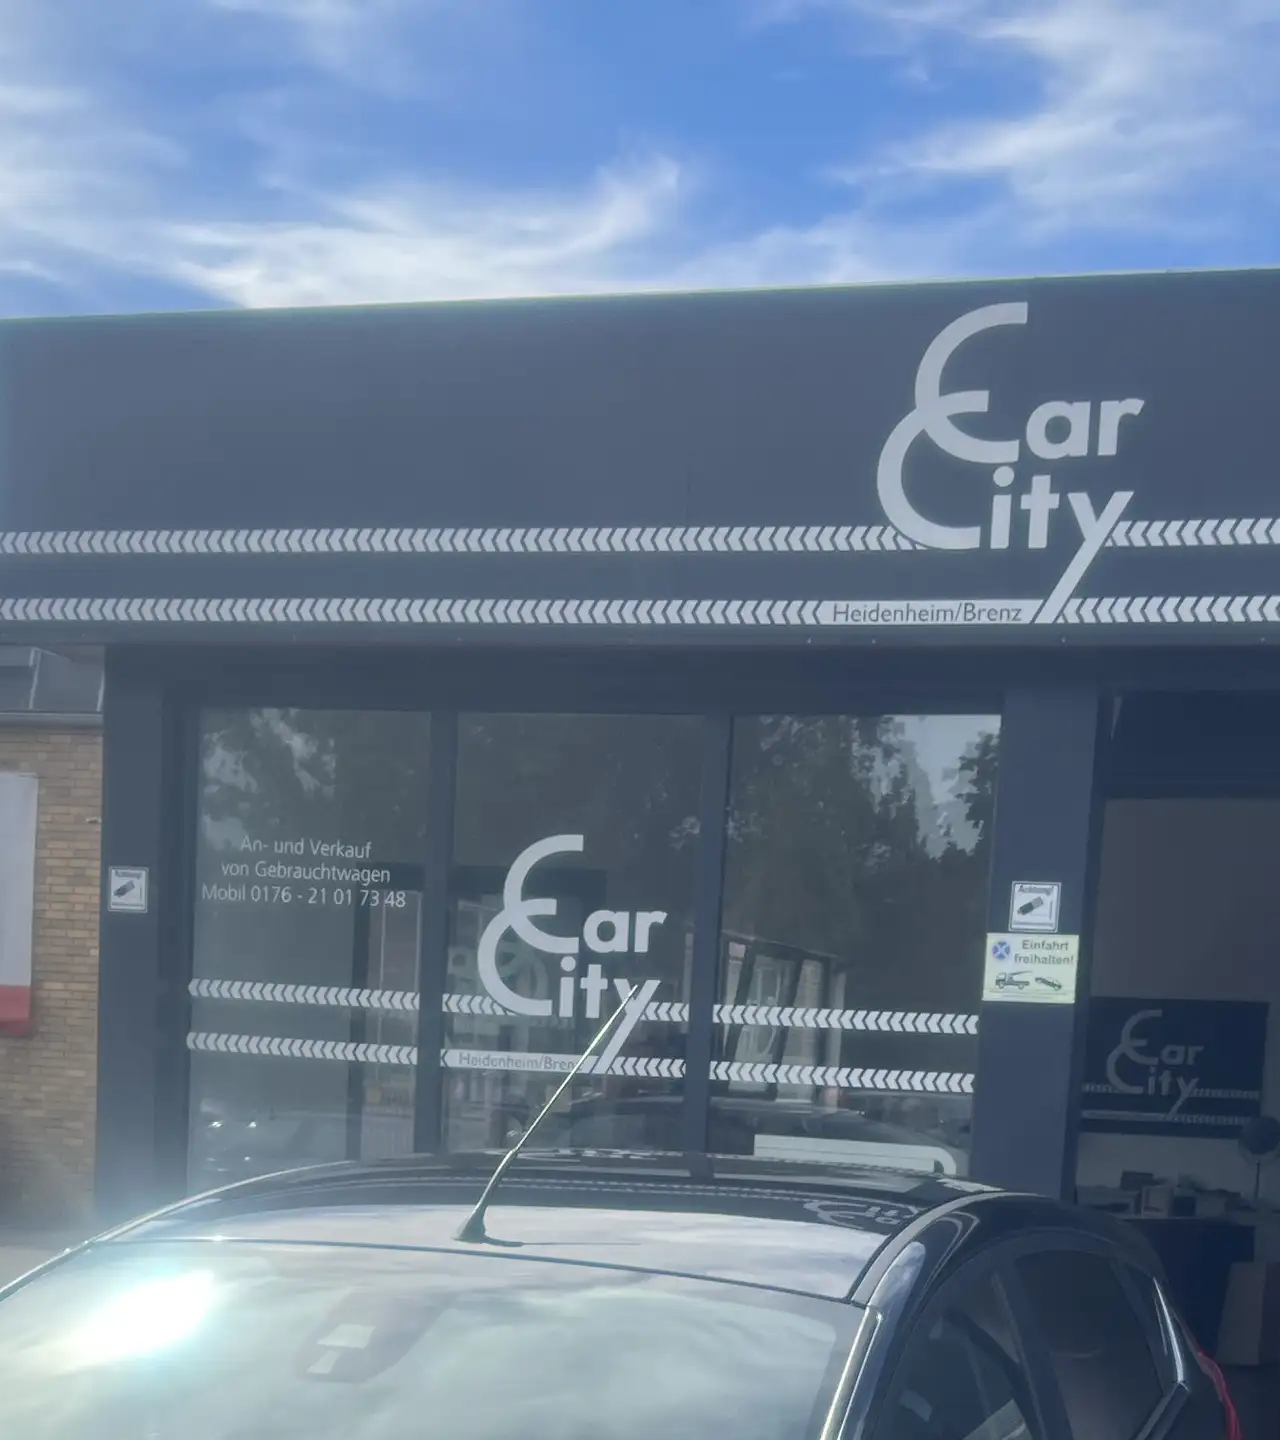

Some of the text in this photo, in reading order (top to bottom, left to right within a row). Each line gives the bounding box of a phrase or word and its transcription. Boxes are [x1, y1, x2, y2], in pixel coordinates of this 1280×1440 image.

[914, 301, 1145, 464] Car
[876, 390, 1135, 624] City
[832, 602, 1023, 623] Heidenheim/Brenz
[220, 860, 391, 886] von Gebrauchtwagen
[240, 835, 372, 859] An- und Verkauf
[201, 883, 246, 902] Mobil
[251, 885, 292, 904] 0176
[307, 887, 327, 905] 21
[333, 888, 353, 906] 01
[359, 889, 380, 908] 73
[384, 891, 407, 909] 48
[502, 834, 668, 954] Car
[1021, 940, 1069, 951] Einfahrt
[476, 898, 661, 1074] City
[1121, 1009, 1205, 1067] Car
[1106, 1039, 1200, 1117] City
